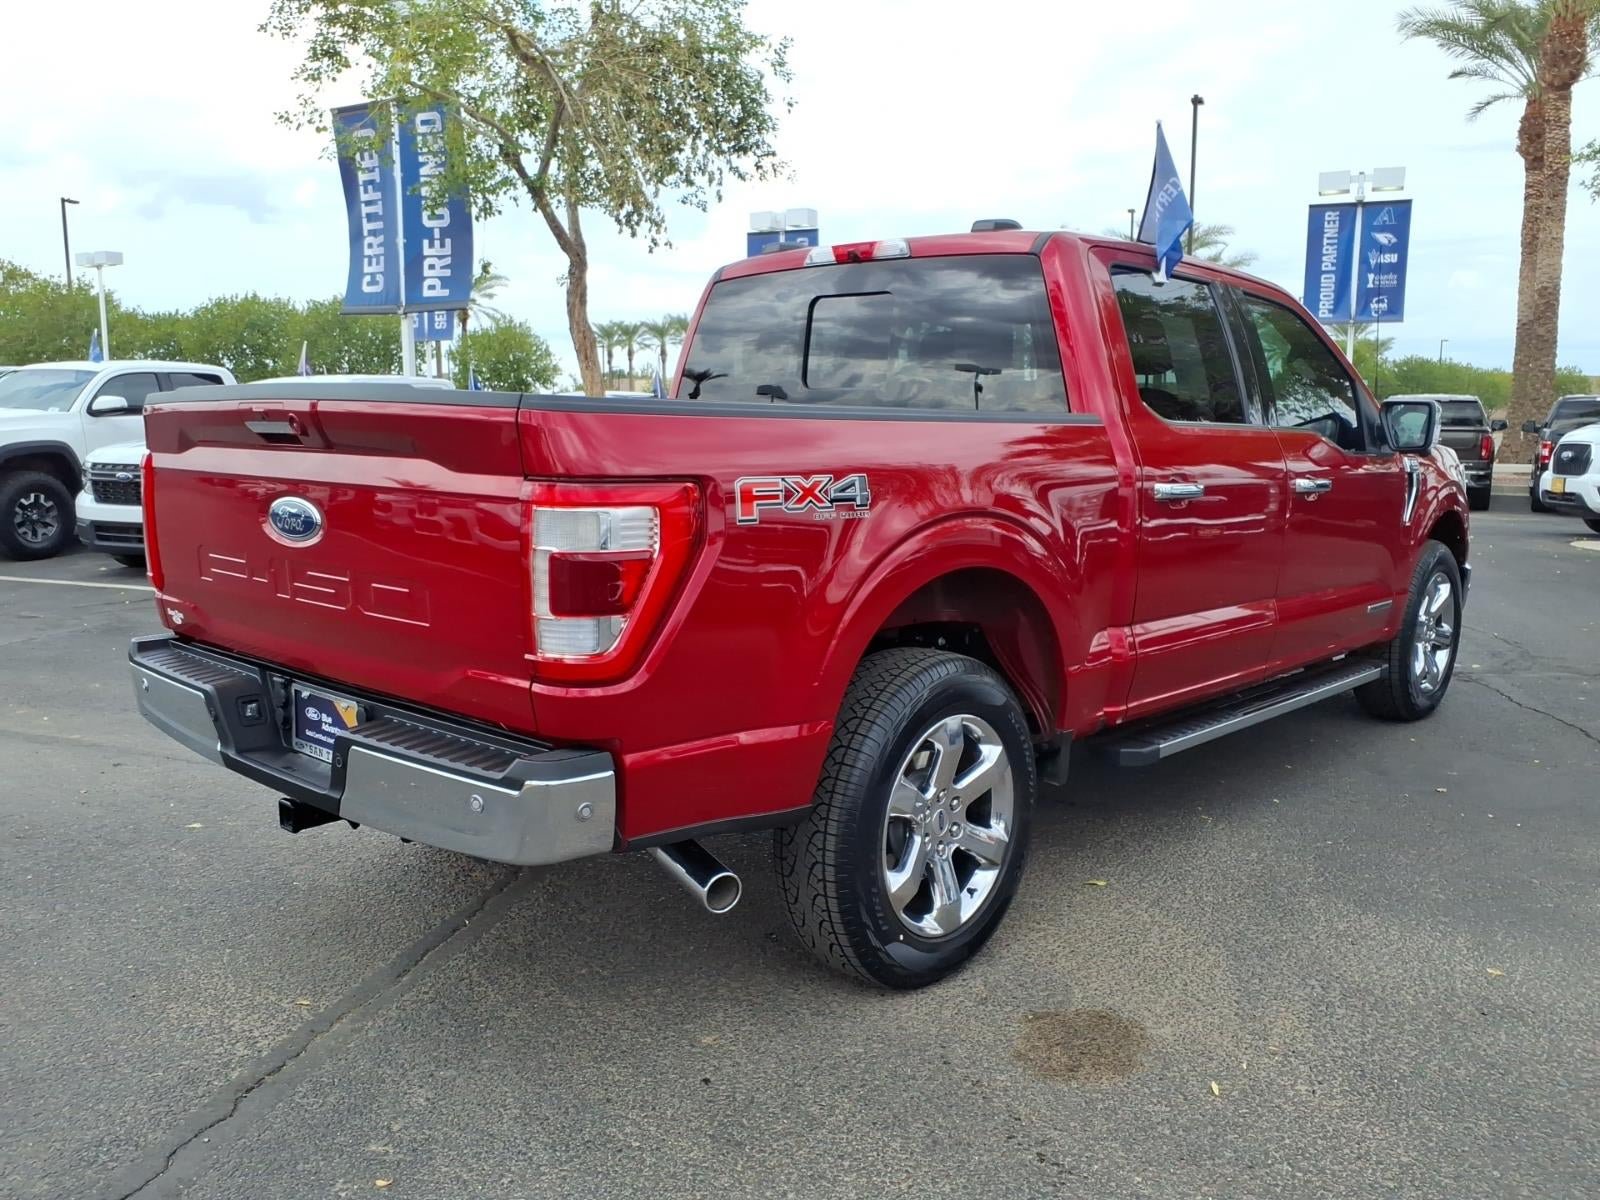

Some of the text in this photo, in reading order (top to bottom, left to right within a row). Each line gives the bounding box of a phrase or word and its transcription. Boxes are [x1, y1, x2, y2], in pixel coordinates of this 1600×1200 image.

[1318, 210, 1341, 319] PROUD PARTNER
[735, 474, 871, 525] FX4
[197, 544, 431, 627] F-150
